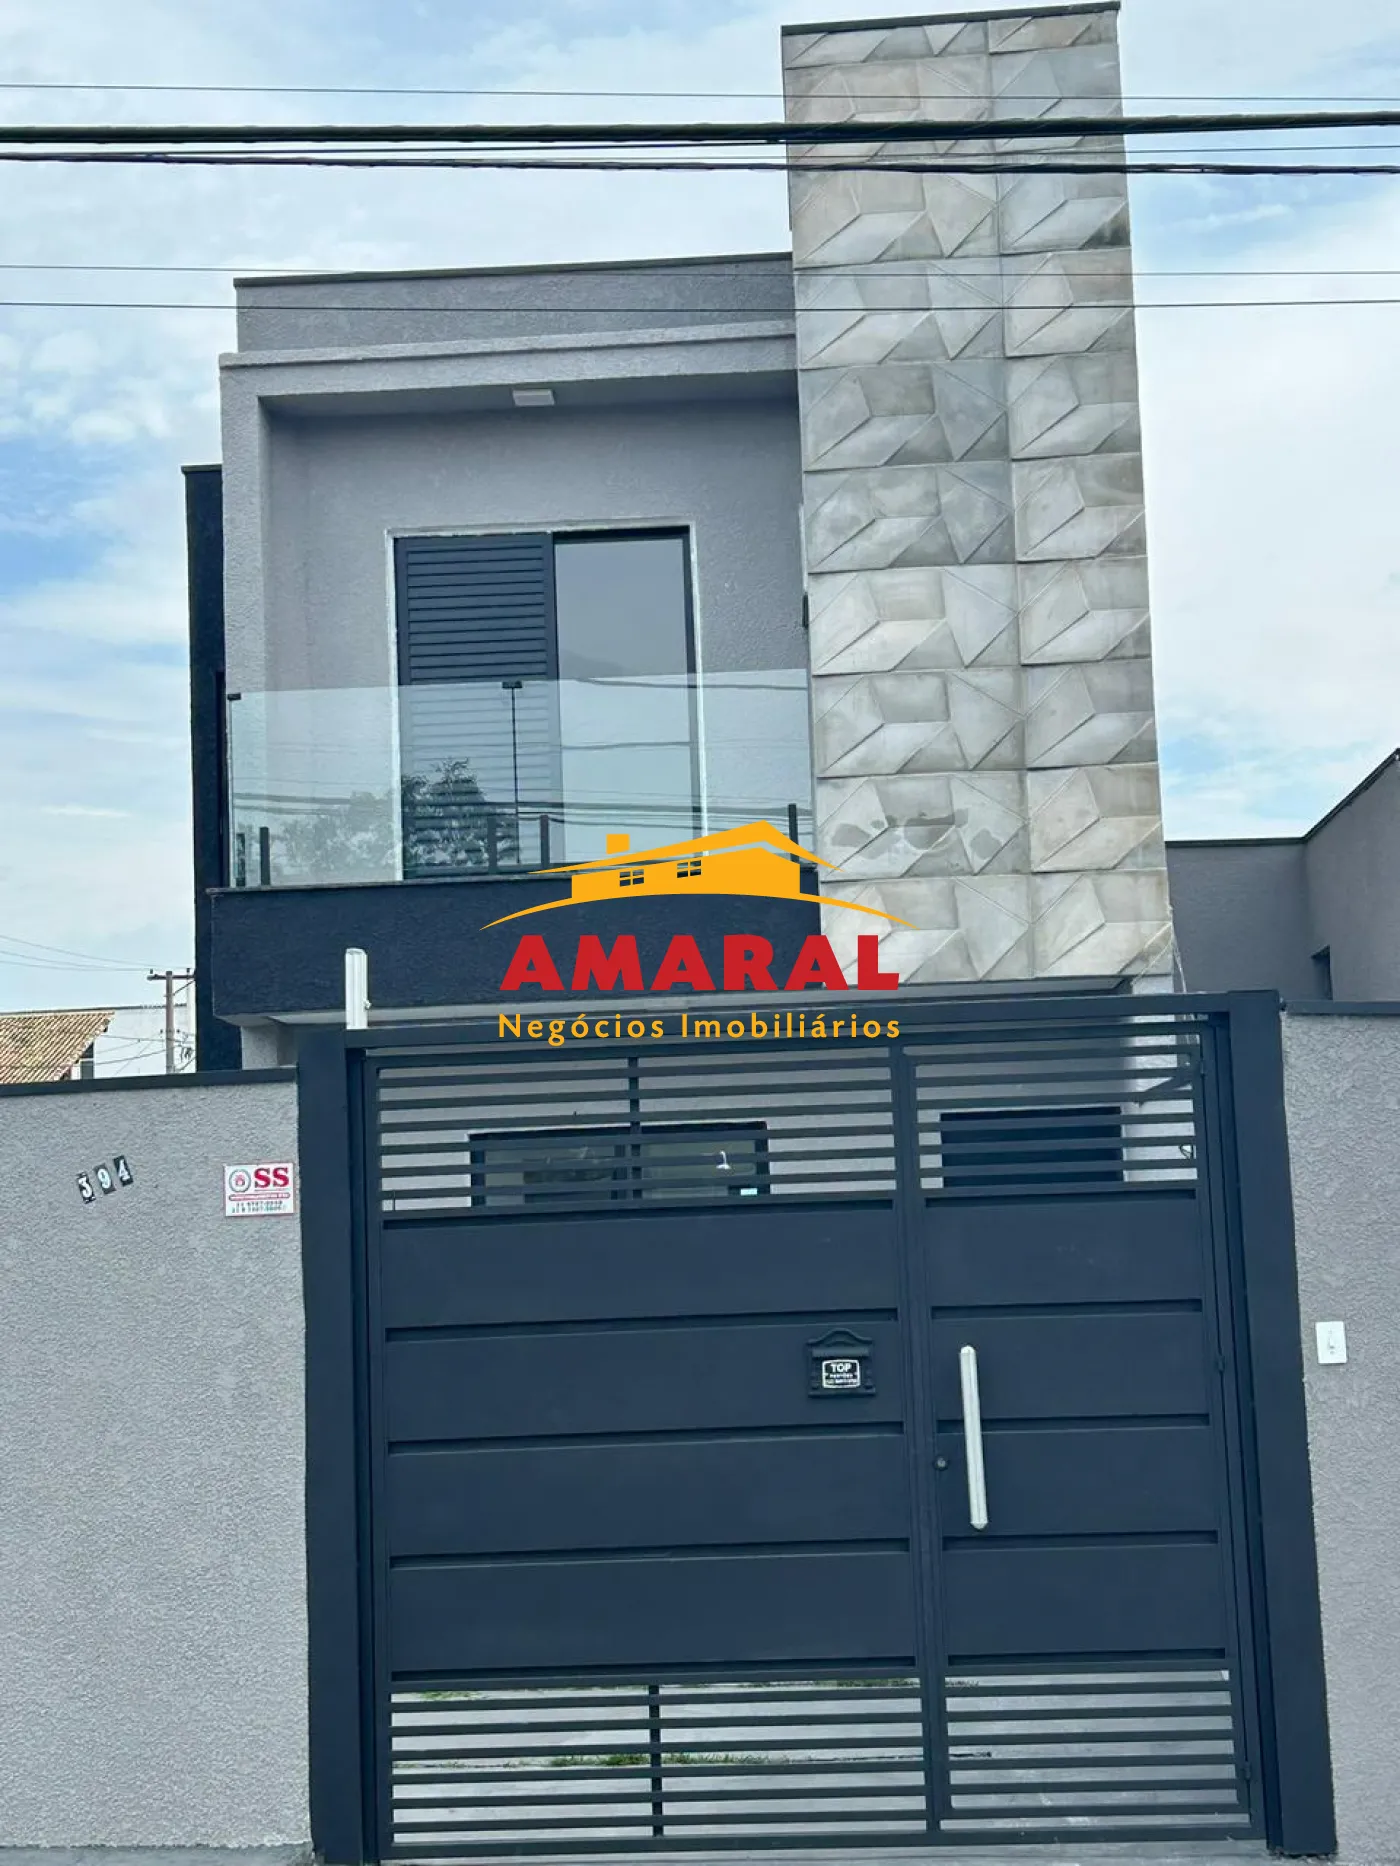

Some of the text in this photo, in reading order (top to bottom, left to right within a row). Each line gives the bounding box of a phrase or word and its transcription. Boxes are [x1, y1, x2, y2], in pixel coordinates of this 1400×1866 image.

[78, 1158, 131, 1198] 394
[254, 1167, 290, 1188] SS
[830, 1362, 851, 1372] TOP
